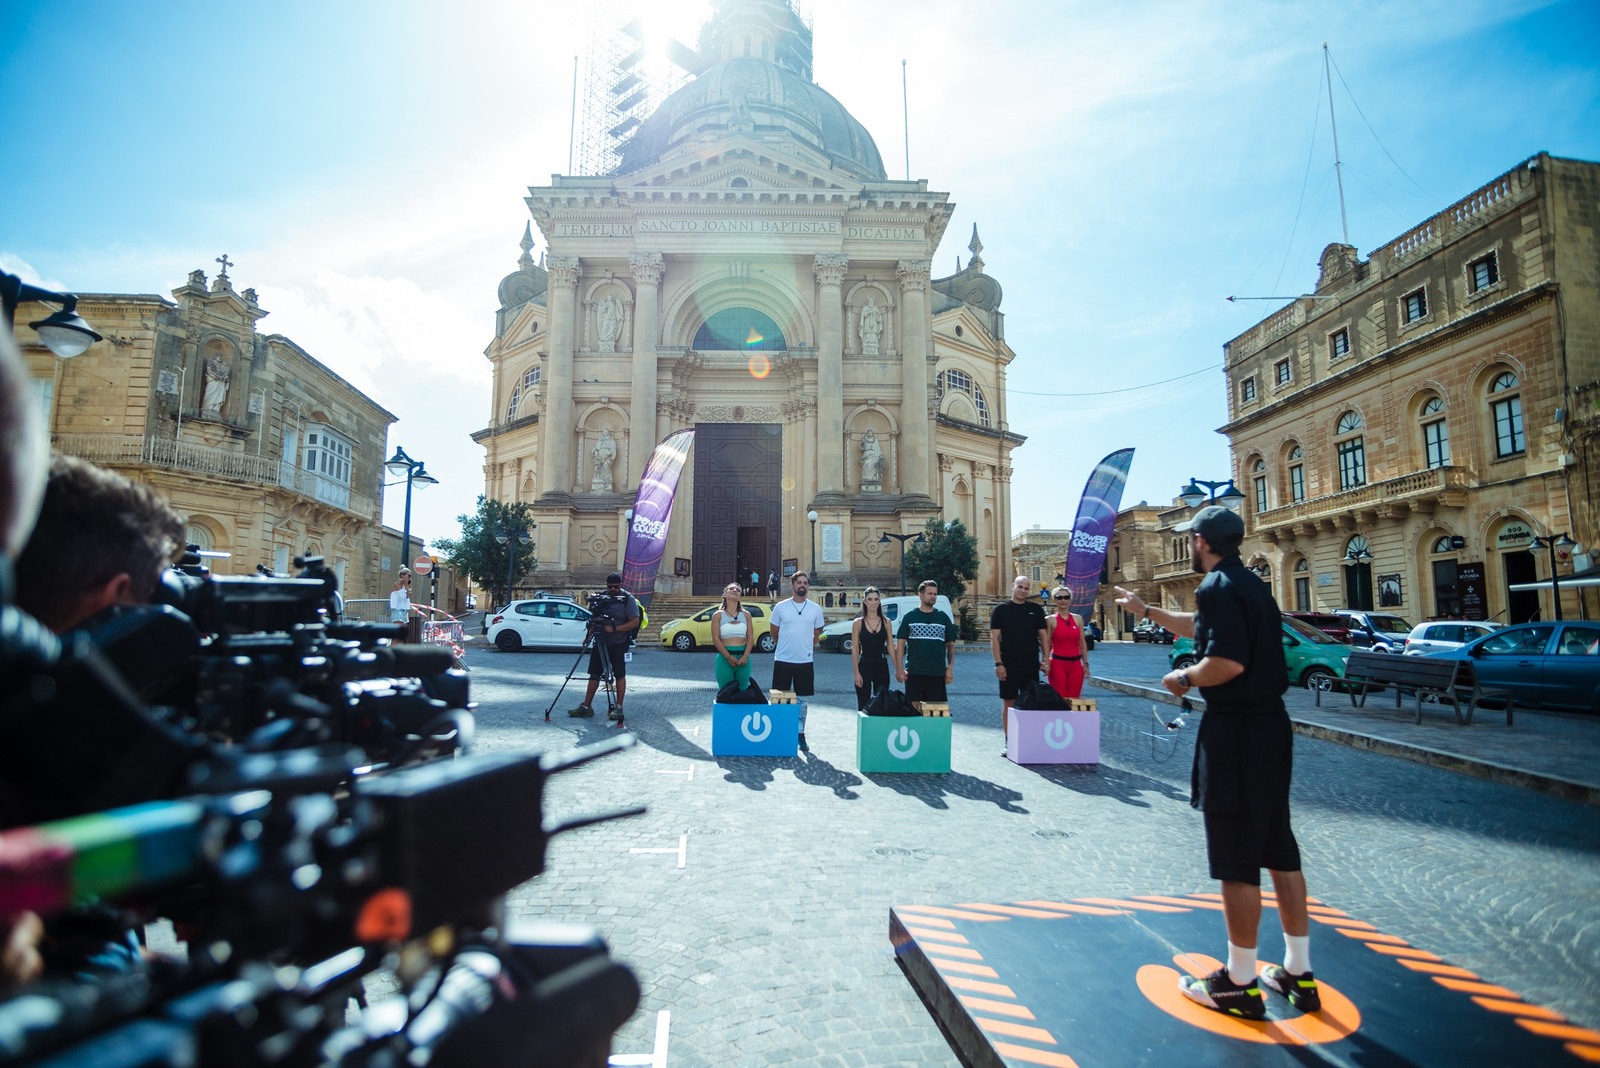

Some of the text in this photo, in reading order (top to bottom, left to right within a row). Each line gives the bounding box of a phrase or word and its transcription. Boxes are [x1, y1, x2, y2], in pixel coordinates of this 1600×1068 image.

[561, 220, 915, 239] TEMPLUM SANCTO JOANNI BAPTISTAE DICATUM
[634, 514, 665, 528] POWER
[633, 523, 664, 539] COUPLE
[1074, 530, 1107, 542] POWER
[1499, 532, 1530, 541] ROTUNDA
[1072, 539, 1106, 553] COUPLE
